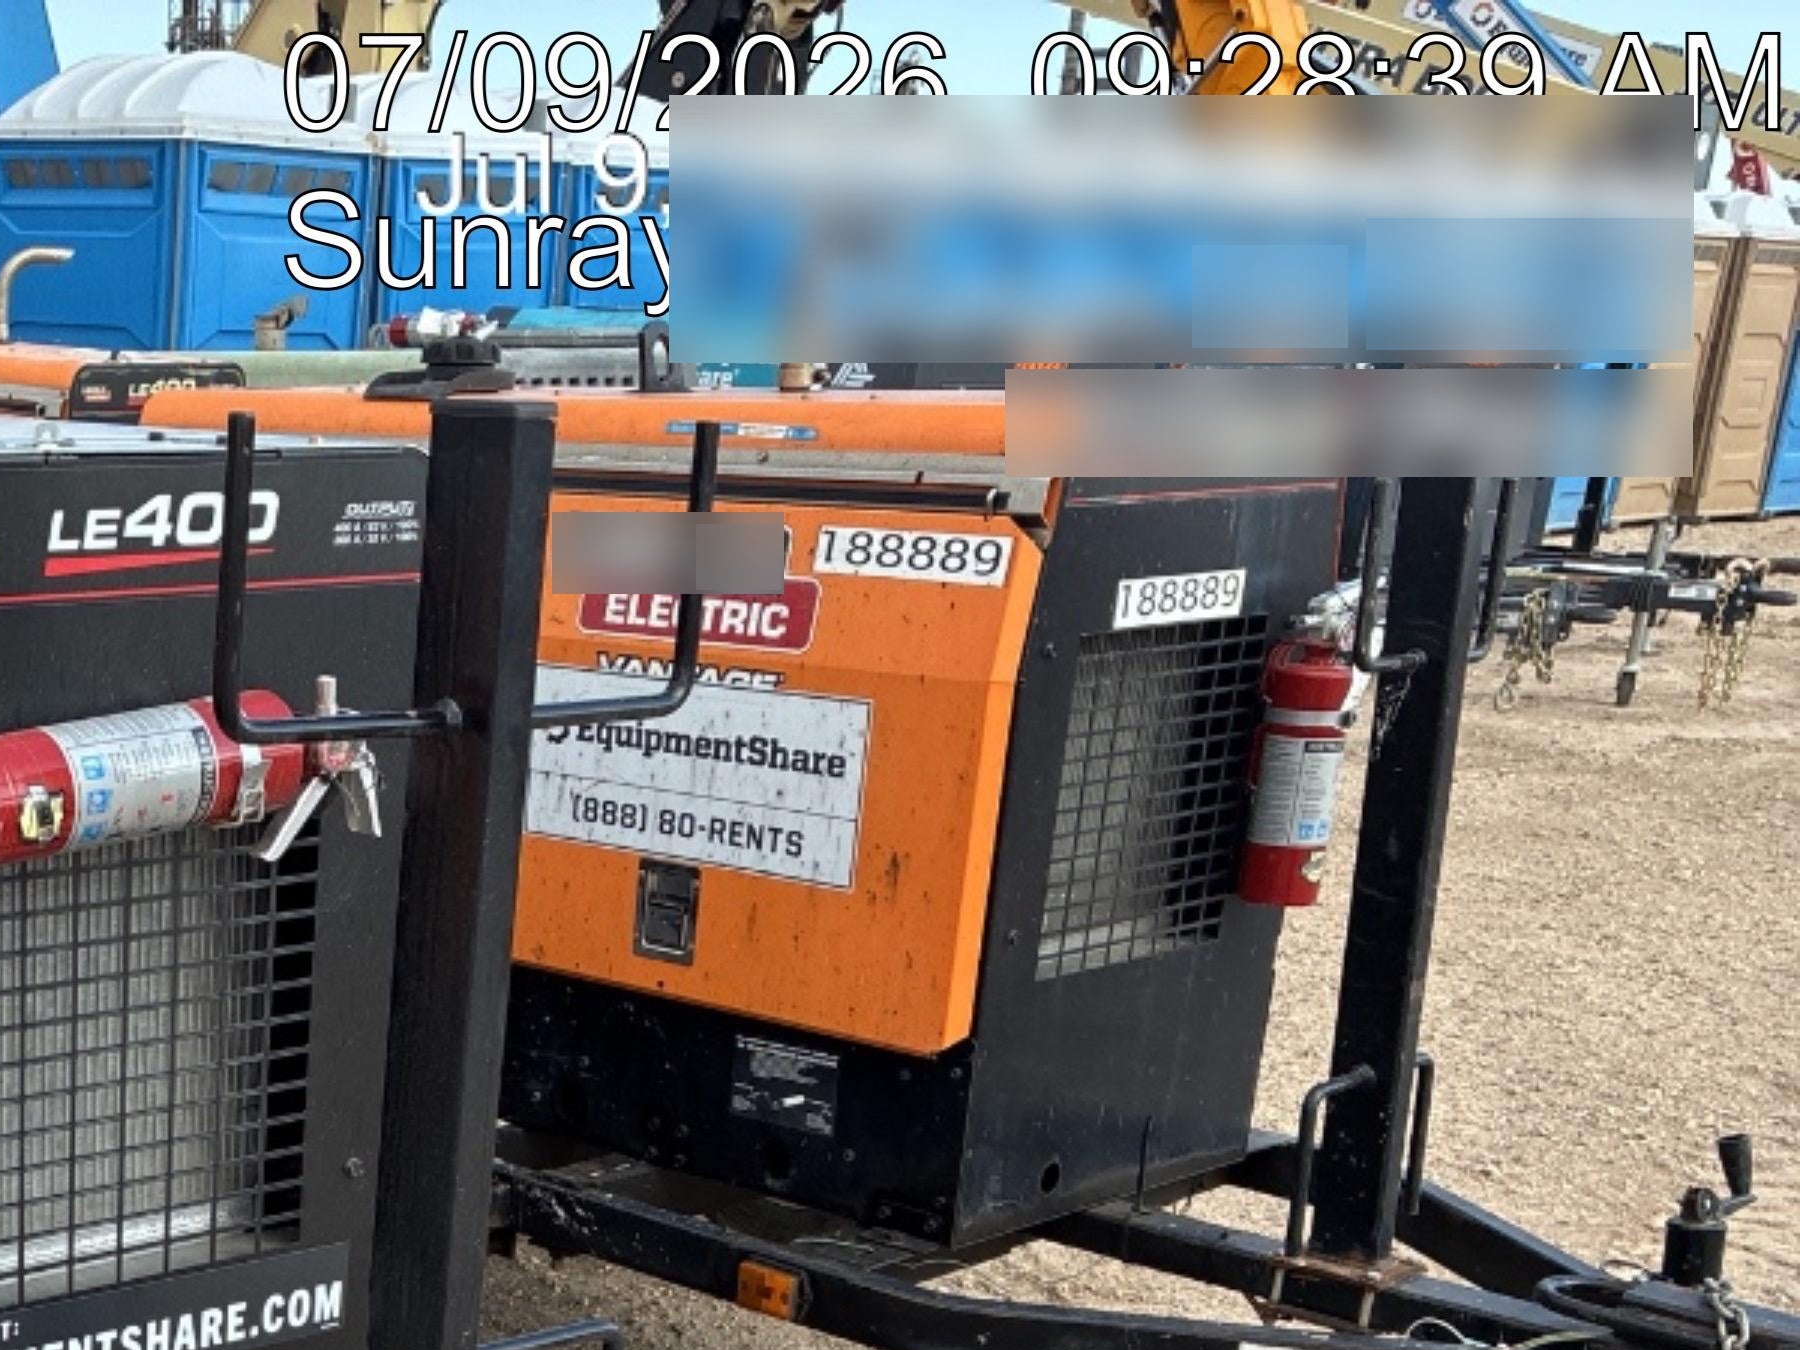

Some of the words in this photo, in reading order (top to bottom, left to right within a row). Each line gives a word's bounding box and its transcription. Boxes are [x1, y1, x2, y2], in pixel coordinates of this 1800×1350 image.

[46, 489, 281, 553] LE400
[822, 530, 1004, 577] 188889
[604, 594, 791, 640] ELETRIC
[1118, 573, 1241, 619] 188889
[571, 794, 649, 832] (888)
[659, 809, 806, 857] 80-RENTS
